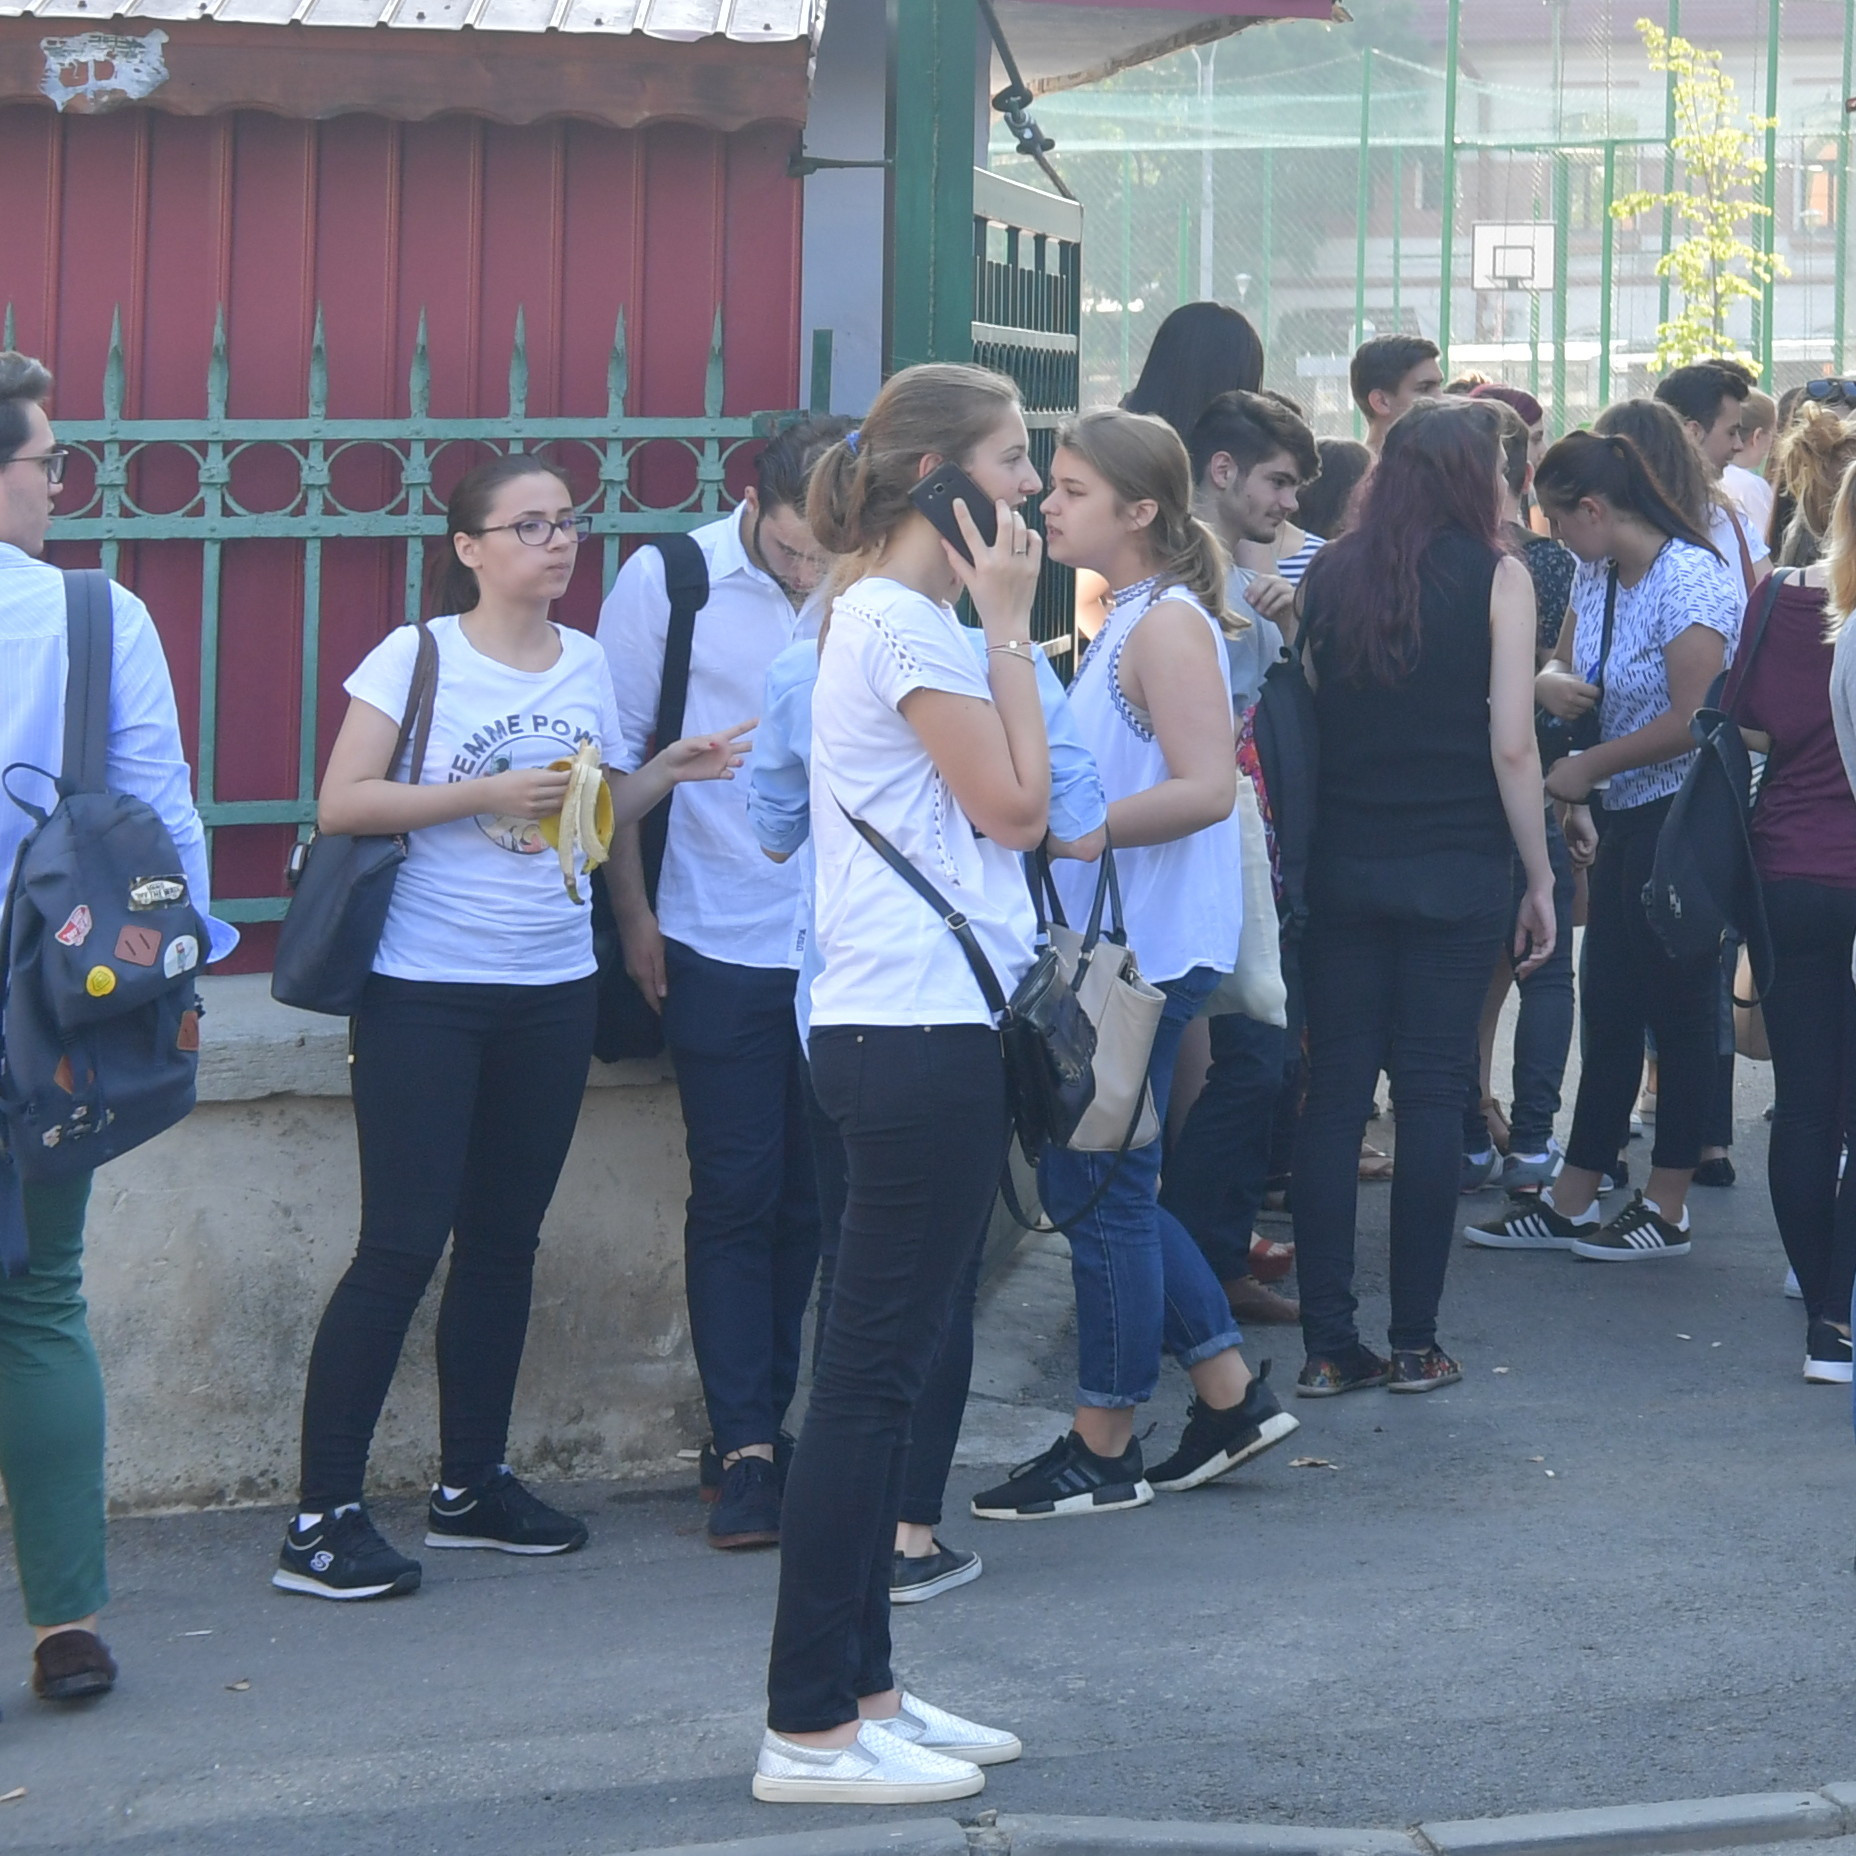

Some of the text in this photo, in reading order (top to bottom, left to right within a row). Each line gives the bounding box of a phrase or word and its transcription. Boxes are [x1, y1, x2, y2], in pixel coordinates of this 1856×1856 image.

[448, 714, 597, 784] FEMME POW
[310, 1550, 334, 1572] S
